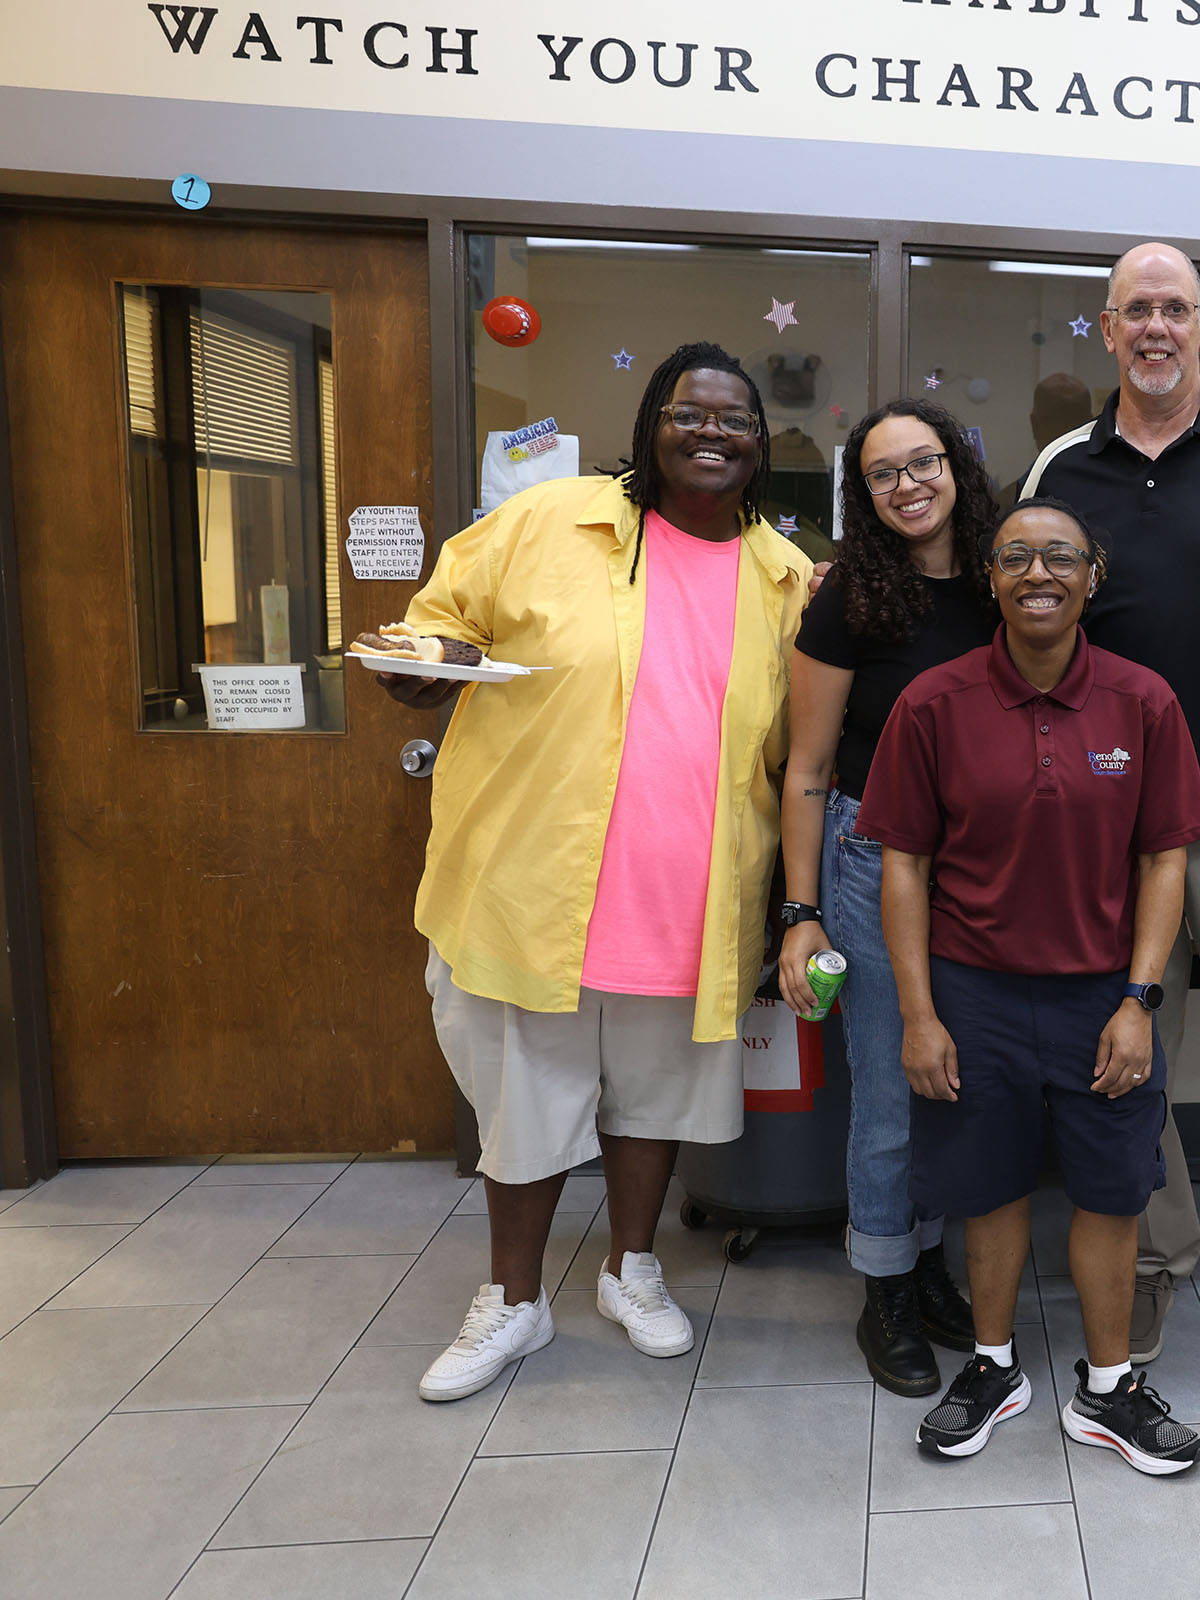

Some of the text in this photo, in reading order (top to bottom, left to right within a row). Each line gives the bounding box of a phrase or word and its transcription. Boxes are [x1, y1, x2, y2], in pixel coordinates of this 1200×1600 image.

[147, 3, 479, 76] WATCH
[536, 34, 760, 93] YOUR
[177, 177, 199, 203] 1
[501, 417, 558, 451] AMERICAN
[350, 517, 418, 526] STEPS PAST THE
[354, 528, 415, 536] TAPE WITHOUT
[347, 538, 424, 546] PERMISSION FROM
[351, 549, 376, 557] STAFF
[353, 559, 420, 567] WILL RECEIVE A
[355, 569, 370, 577] $25
[225, 706, 240, 714] NOT
[244, 706, 279, 714] OCCUPIED
[1087, 751, 1113, 761] Reno
[1091, 760, 1125, 771] County
[750, 996, 776, 1007] SH
[742, 1036, 772, 1050] NLY
